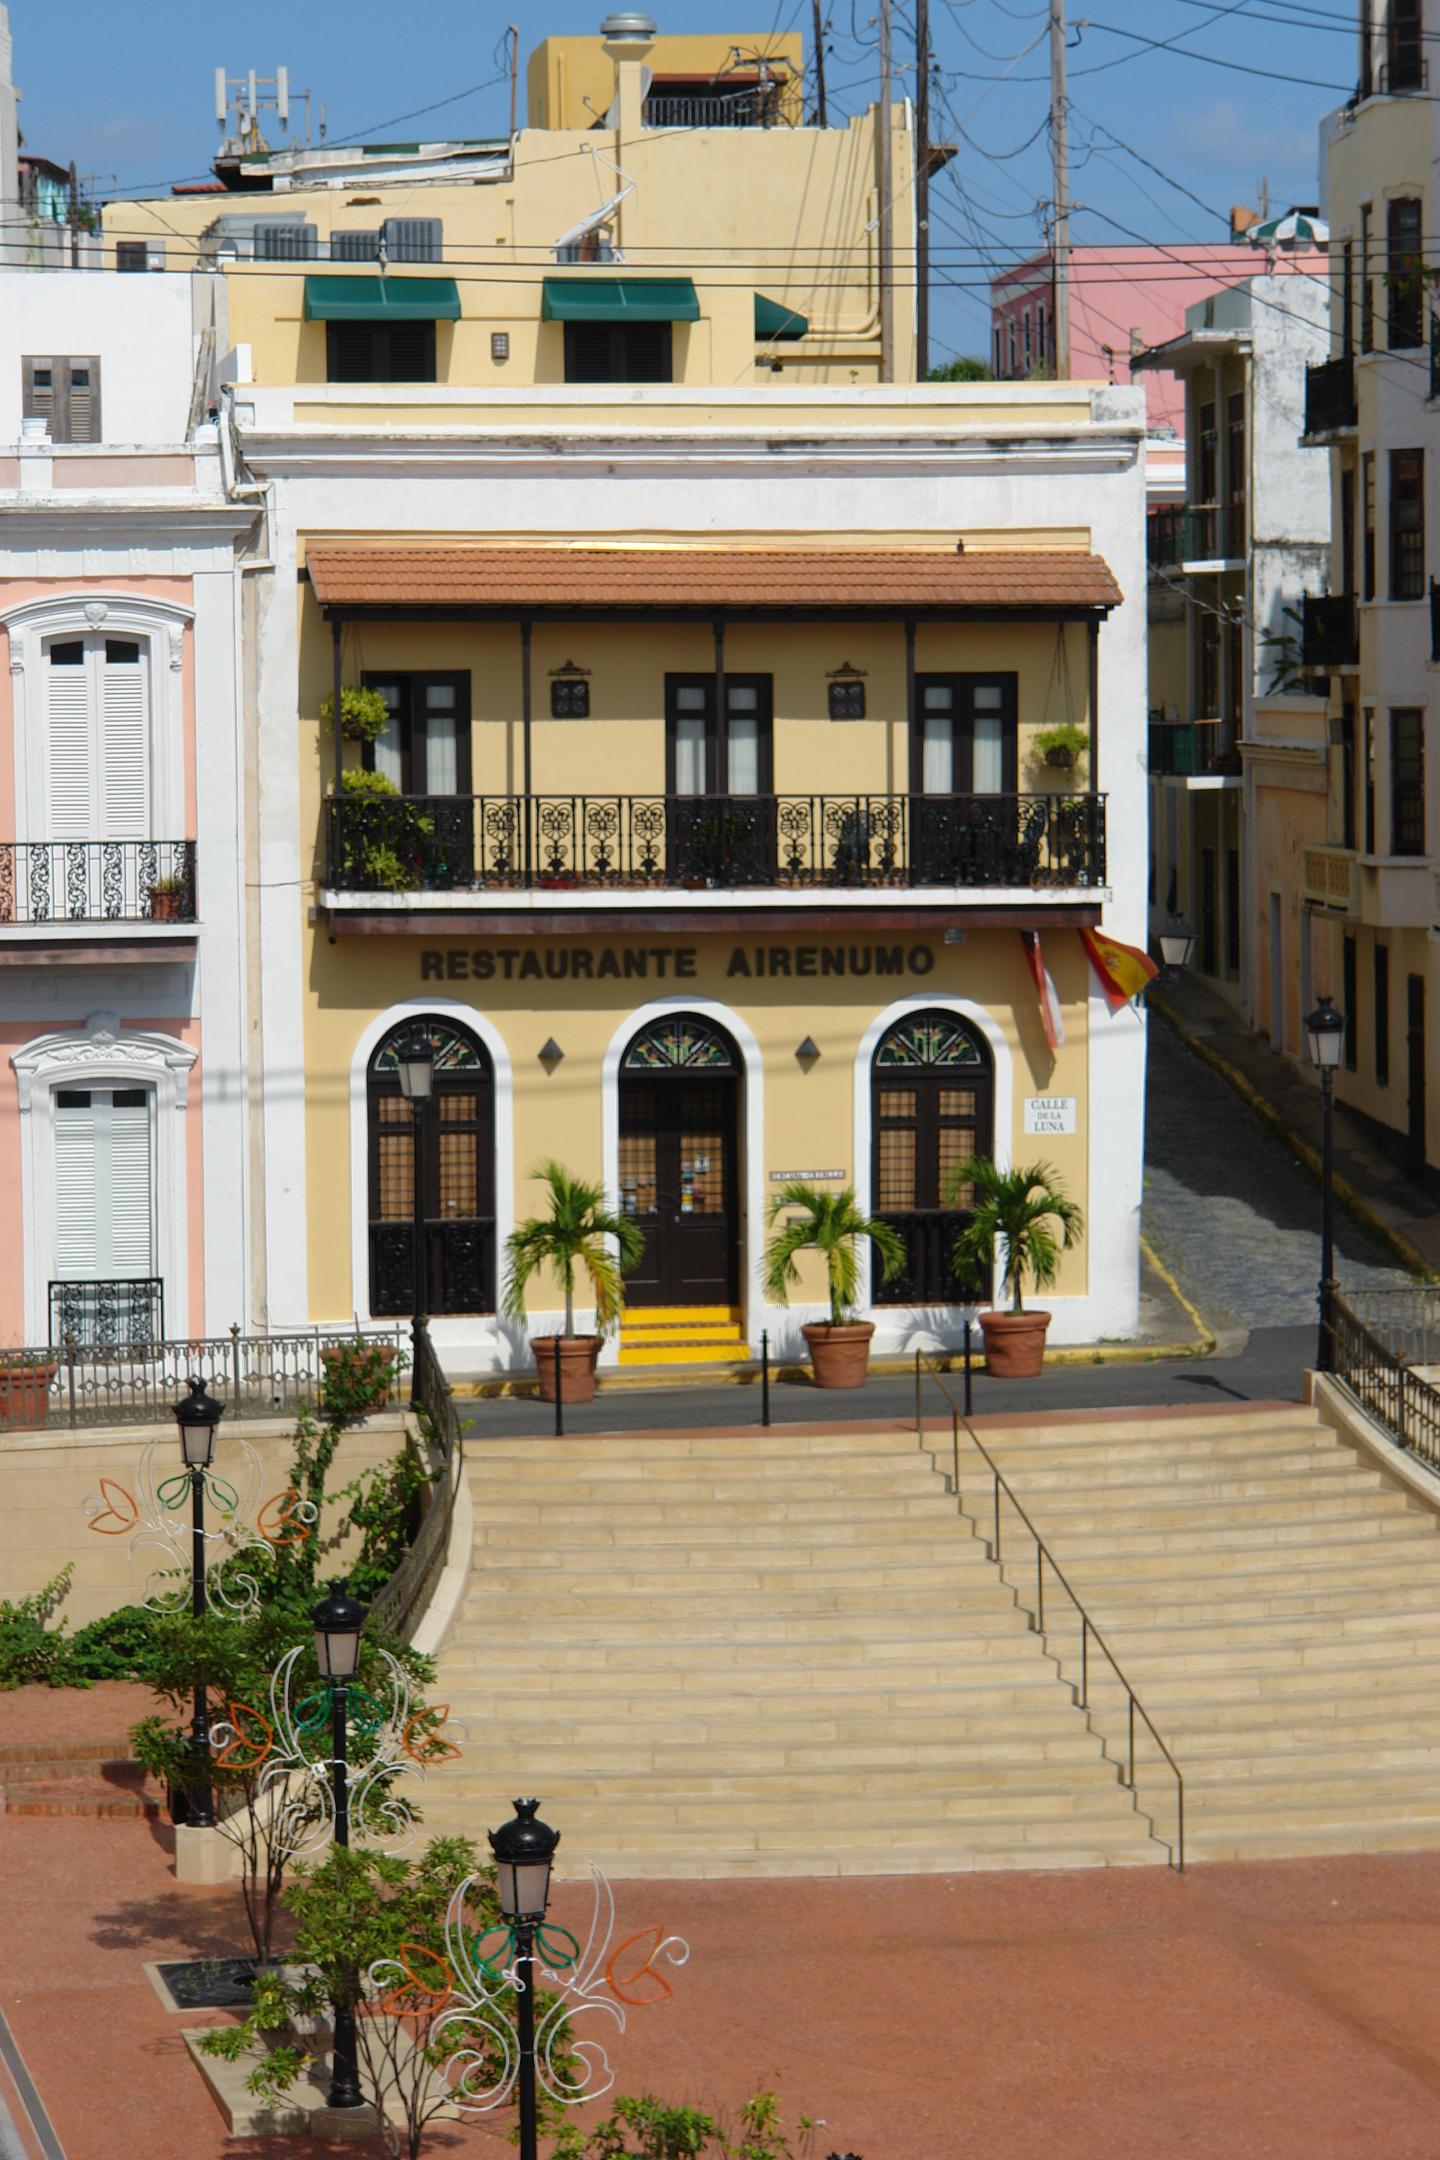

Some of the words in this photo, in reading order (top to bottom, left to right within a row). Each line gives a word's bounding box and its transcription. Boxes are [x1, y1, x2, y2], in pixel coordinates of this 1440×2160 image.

[421, 949, 697, 980] RESTAURANTE
[727, 946, 935, 977] AIRENUMO
[1030, 1100, 1067, 1109] CALLE
[1034, 1121, 1064, 1131] LUNA
